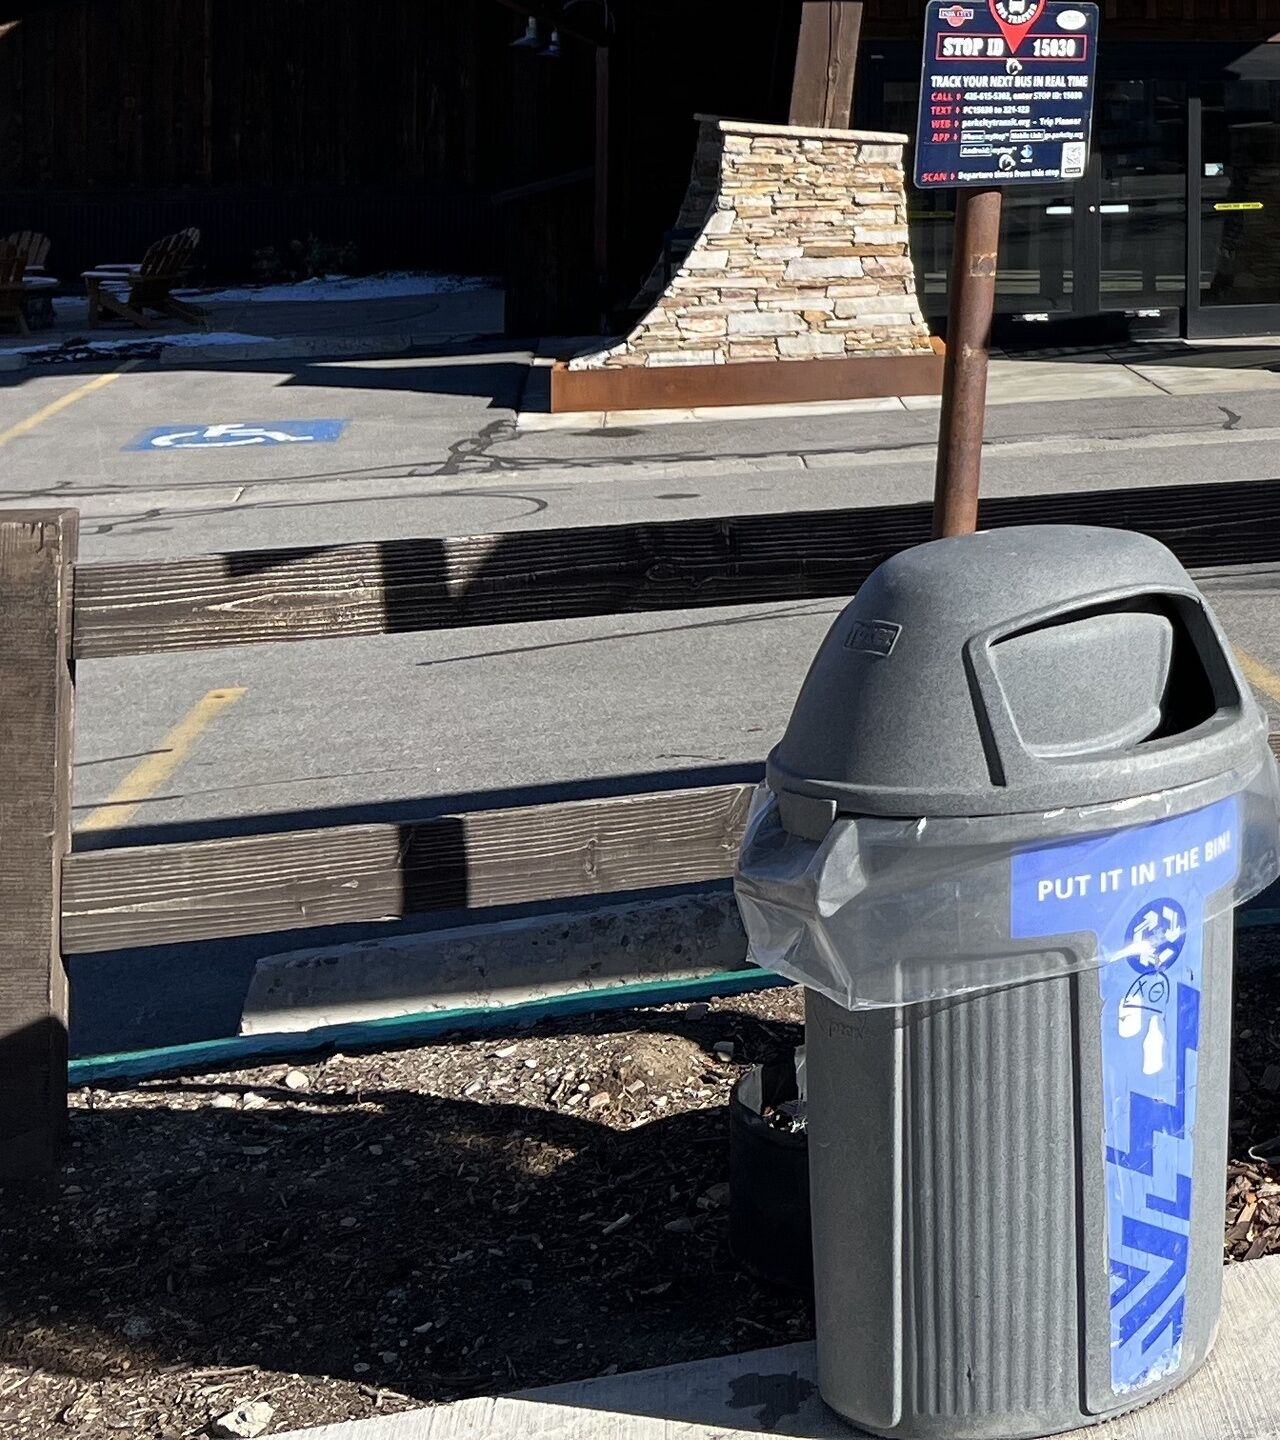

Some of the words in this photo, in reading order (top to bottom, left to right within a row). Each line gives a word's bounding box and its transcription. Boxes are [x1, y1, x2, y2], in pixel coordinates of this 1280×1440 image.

[942, 37, 983, 57] STOP
[987, 38, 1004, 56] ID
[1033, 38, 1076, 57] 15030
[931, 76, 962, 88] TRACK
[963, 76, 989, 88] YOUR
[989, 76, 1014, 88] NEXT
[1015, 76, 1032, 88] BUS
[1033, 76, 1044, 88] IN
[1045, 76, 1067, 88] REAL
[1068, 76, 1088, 88] TIME
[931, 93, 953, 102] CALL
[1033, 92, 1051, 100] STOP
[930, 106, 952, 115] TEXT
[931, 119, 951, 128] WEB
[962, 117, 1030, 129] parkcitytransit.org
[1039, 117, 1054, 127] Trip
[1054, 117, 1081, 126] Planner
[931, 133, 950, 142] APP
[922, 172, 946, 183] SCAN
[958, 170, 993, 181] Departure
[994, 170, 1013, 179] times
[1014, 169, 1030, 178] from
[1031, 169, 1044, 177] this
[1045, 169, 1060, 178] stop
[1037, 874, 1091, 901] PUT
[1100, 868, 1123, 893] IT
[1131, 861, 1156, 887] IN
[1162, 847, 1199, 877] THE
[1204, 830, 1230, 862] BIN!
